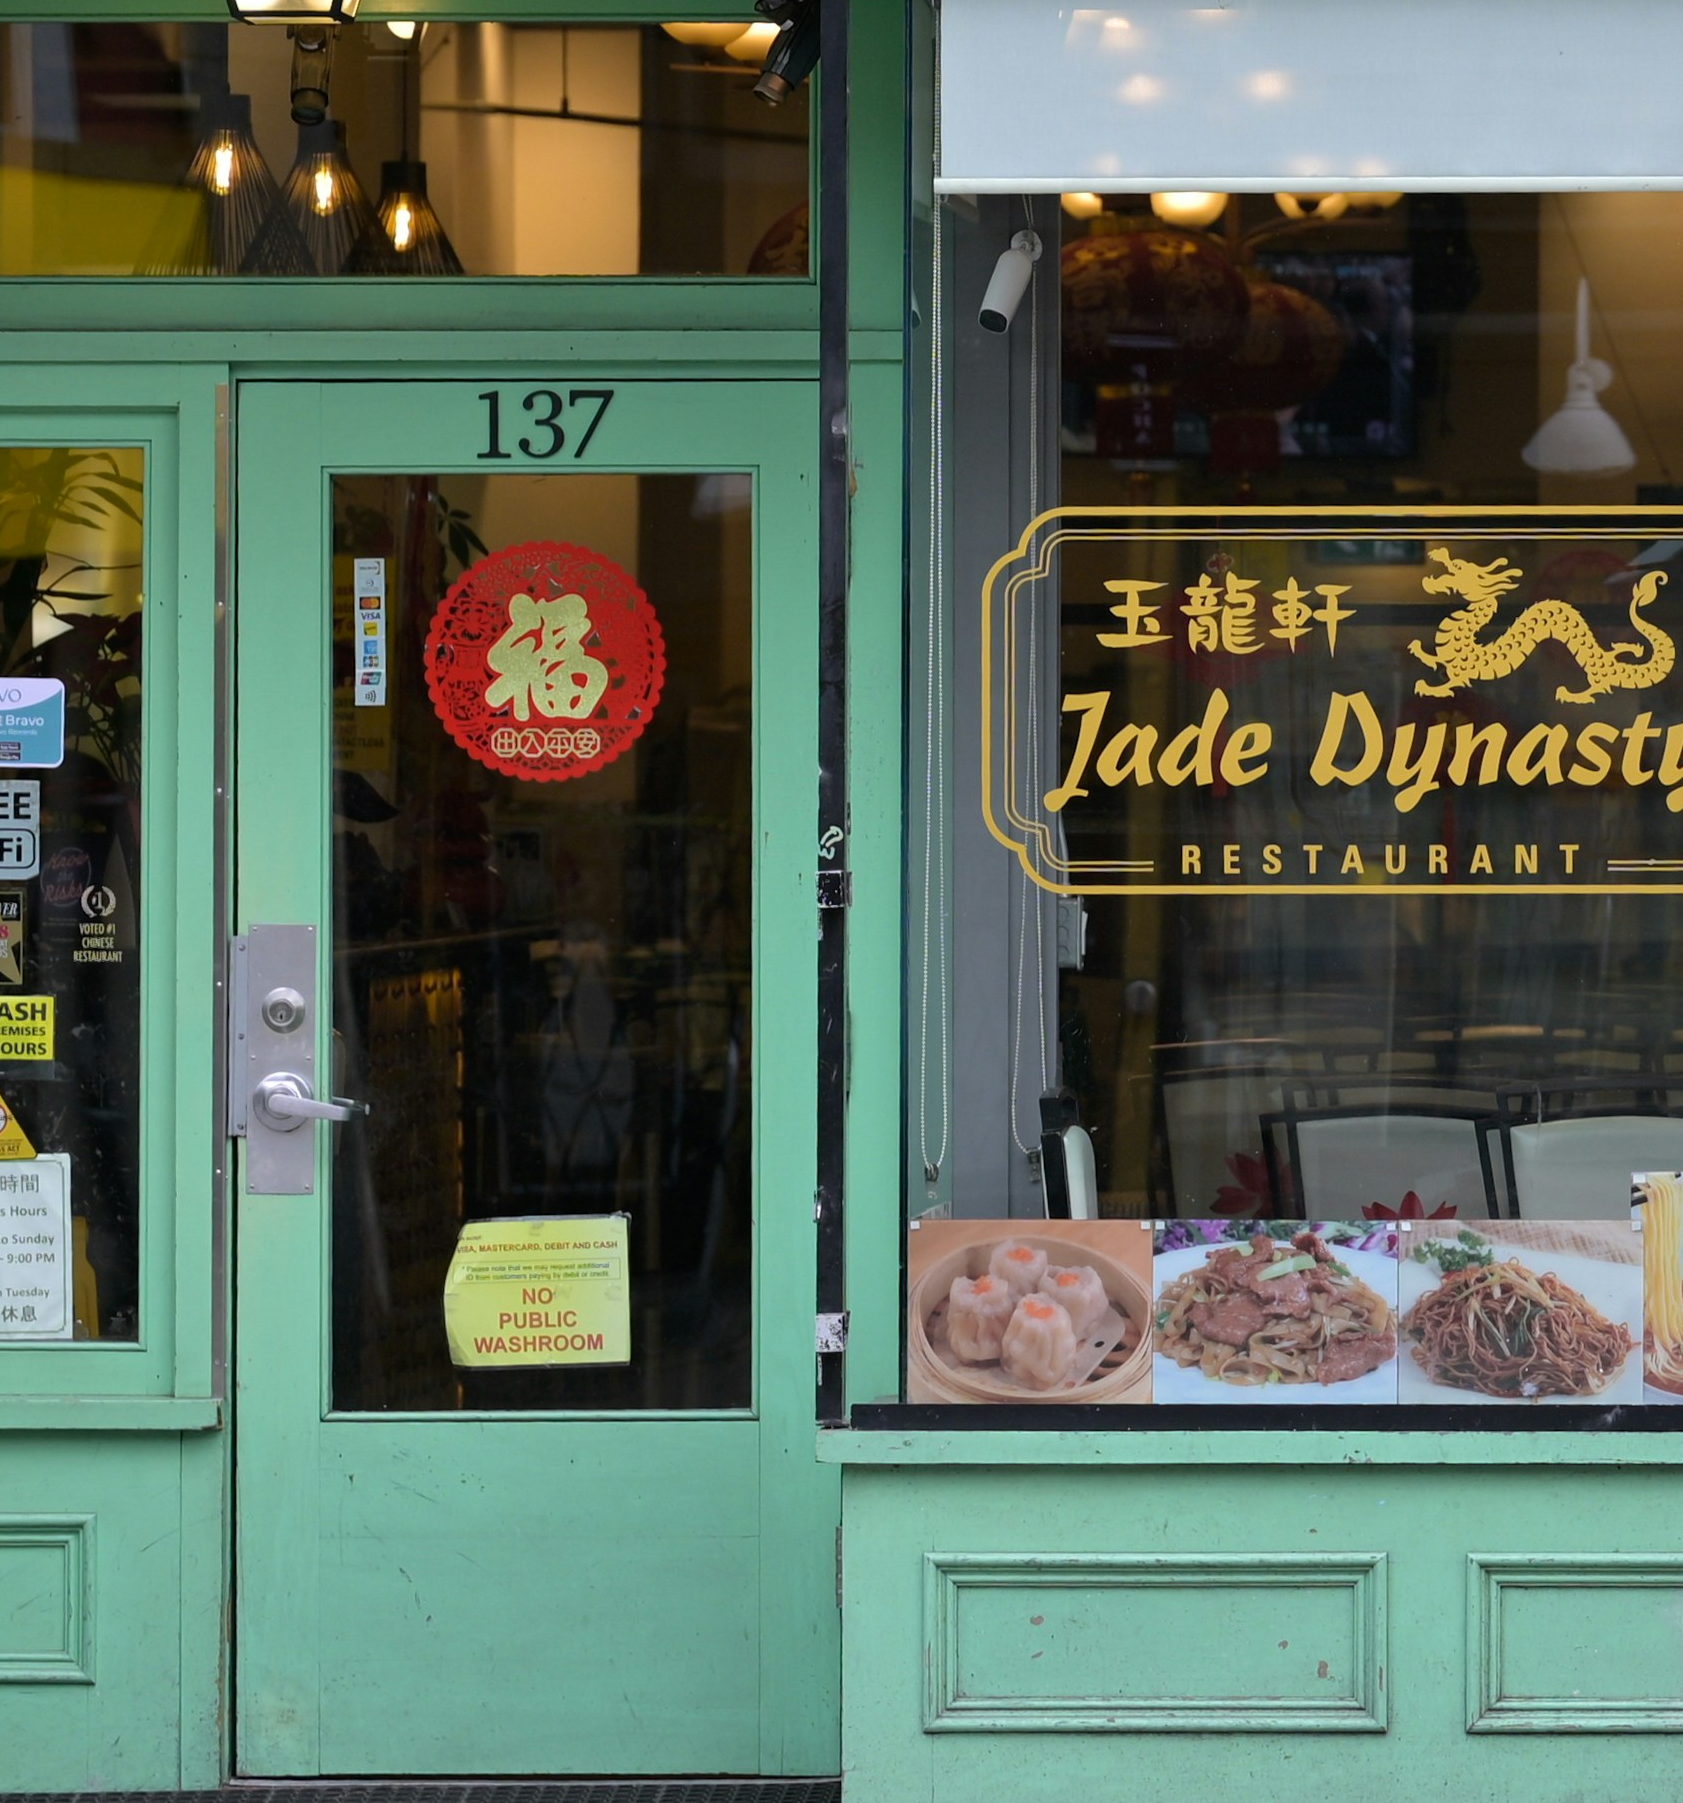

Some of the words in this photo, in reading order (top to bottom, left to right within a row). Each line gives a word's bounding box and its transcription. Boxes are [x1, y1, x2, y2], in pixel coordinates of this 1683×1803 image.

[476, 389, 615, 460] 137
[360, 612, 382, 622] VISA
[1095, 572, 1358, 660] 玉龍軒
[484, 592, 609, 722] 福
[5, 714, 45, 727] Bravo
[1042, 687, 1273, 813] Jade
[1180, 842, 1582, 876] RESTAURANT
[78, 923, 105, 936] VOTED
[81, 936, 115, 949] CHINESE
[73, 950, 123, 964] RESTAURANT
[10, 1205, 48, 1218] Hours
[11, 1232, 55, 1247] Sunday
[544, 1242, 570, 1251] DEBIT
[572, 1241, 592, 1250] AND
[593, 1240, 618, 1249] CASH
[6, 1252, 34, 1264] 9:00
[35, 1252, 56, 1263] PM
[577, 1261, 610, 1270] additional
[5, 1285, 51, 1300] Tuesday
[521, 1288, 554, 1305] NO
[499, 1310, 578, 1329] PUBLIC
[474, 1333, 604, 1353] WASHROOM
